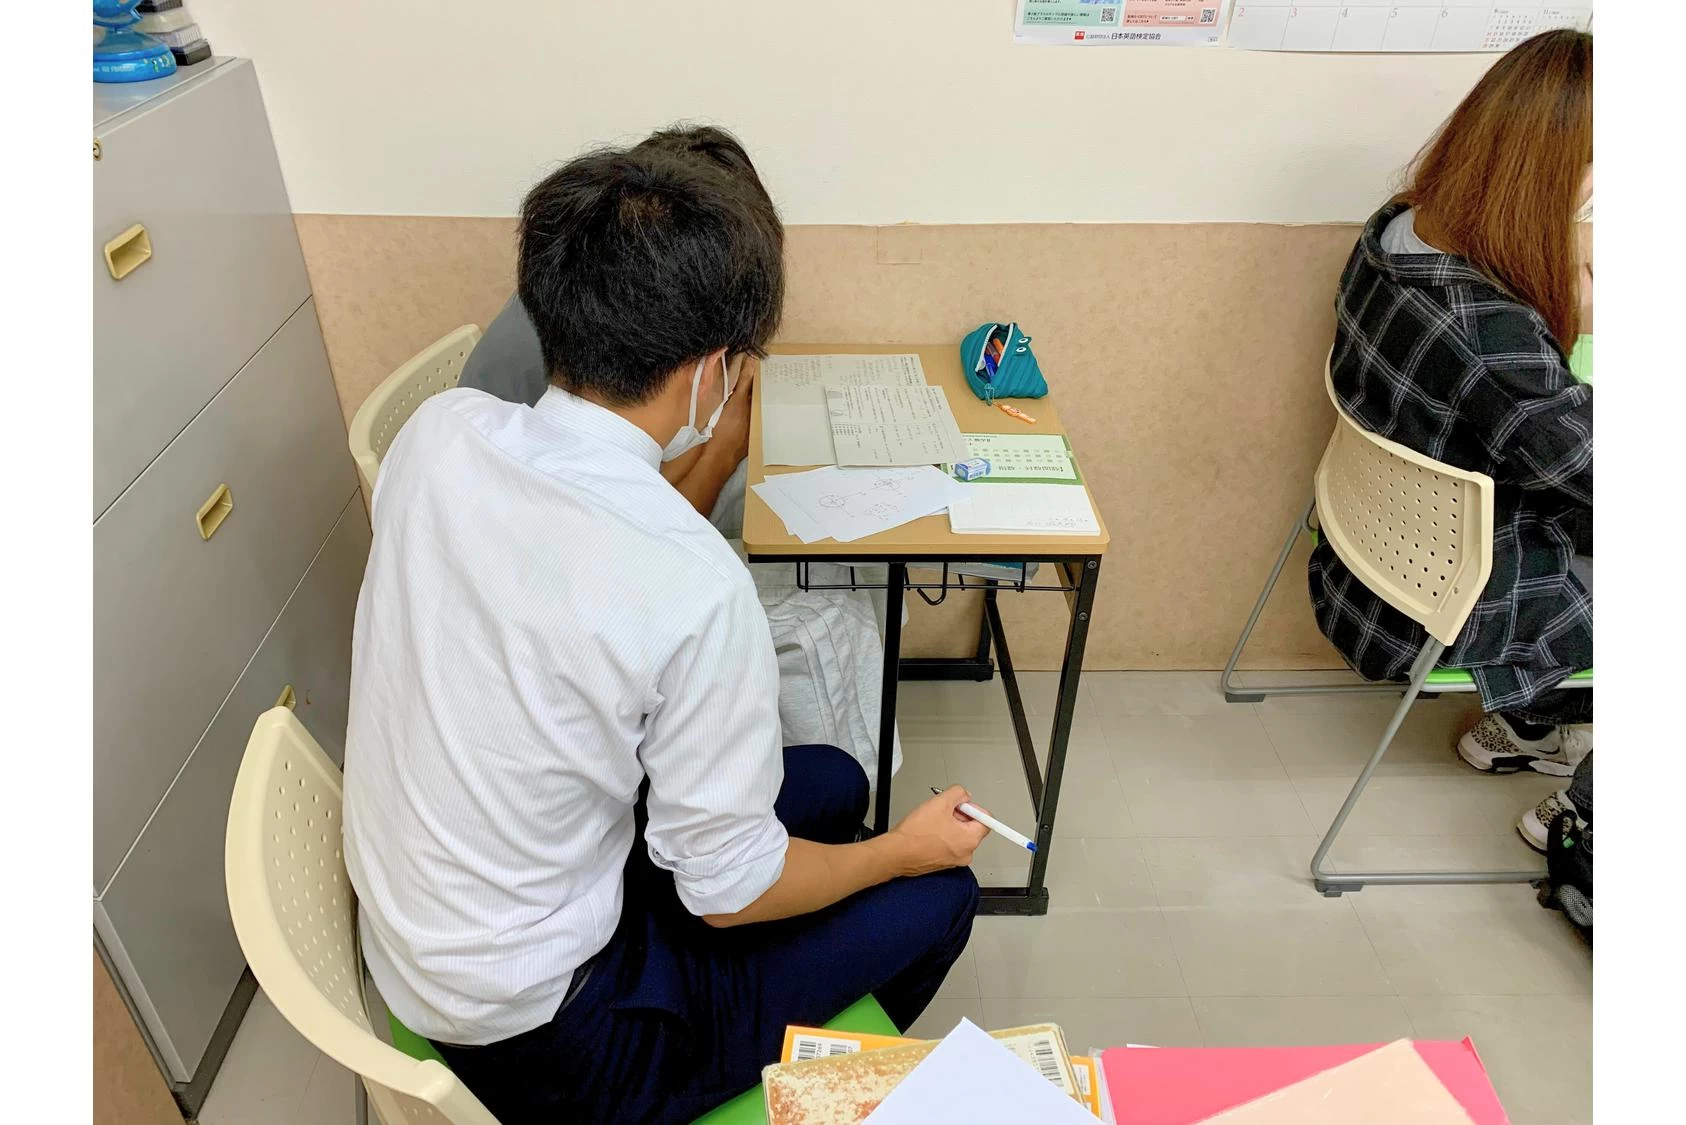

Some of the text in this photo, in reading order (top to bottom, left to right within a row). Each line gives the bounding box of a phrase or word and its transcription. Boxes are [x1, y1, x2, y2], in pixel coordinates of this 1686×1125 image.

[1238, 8, 1449, 18] 2 3 4 5 6
[1111, 32, 1161, 40] 日本英語検定協会
